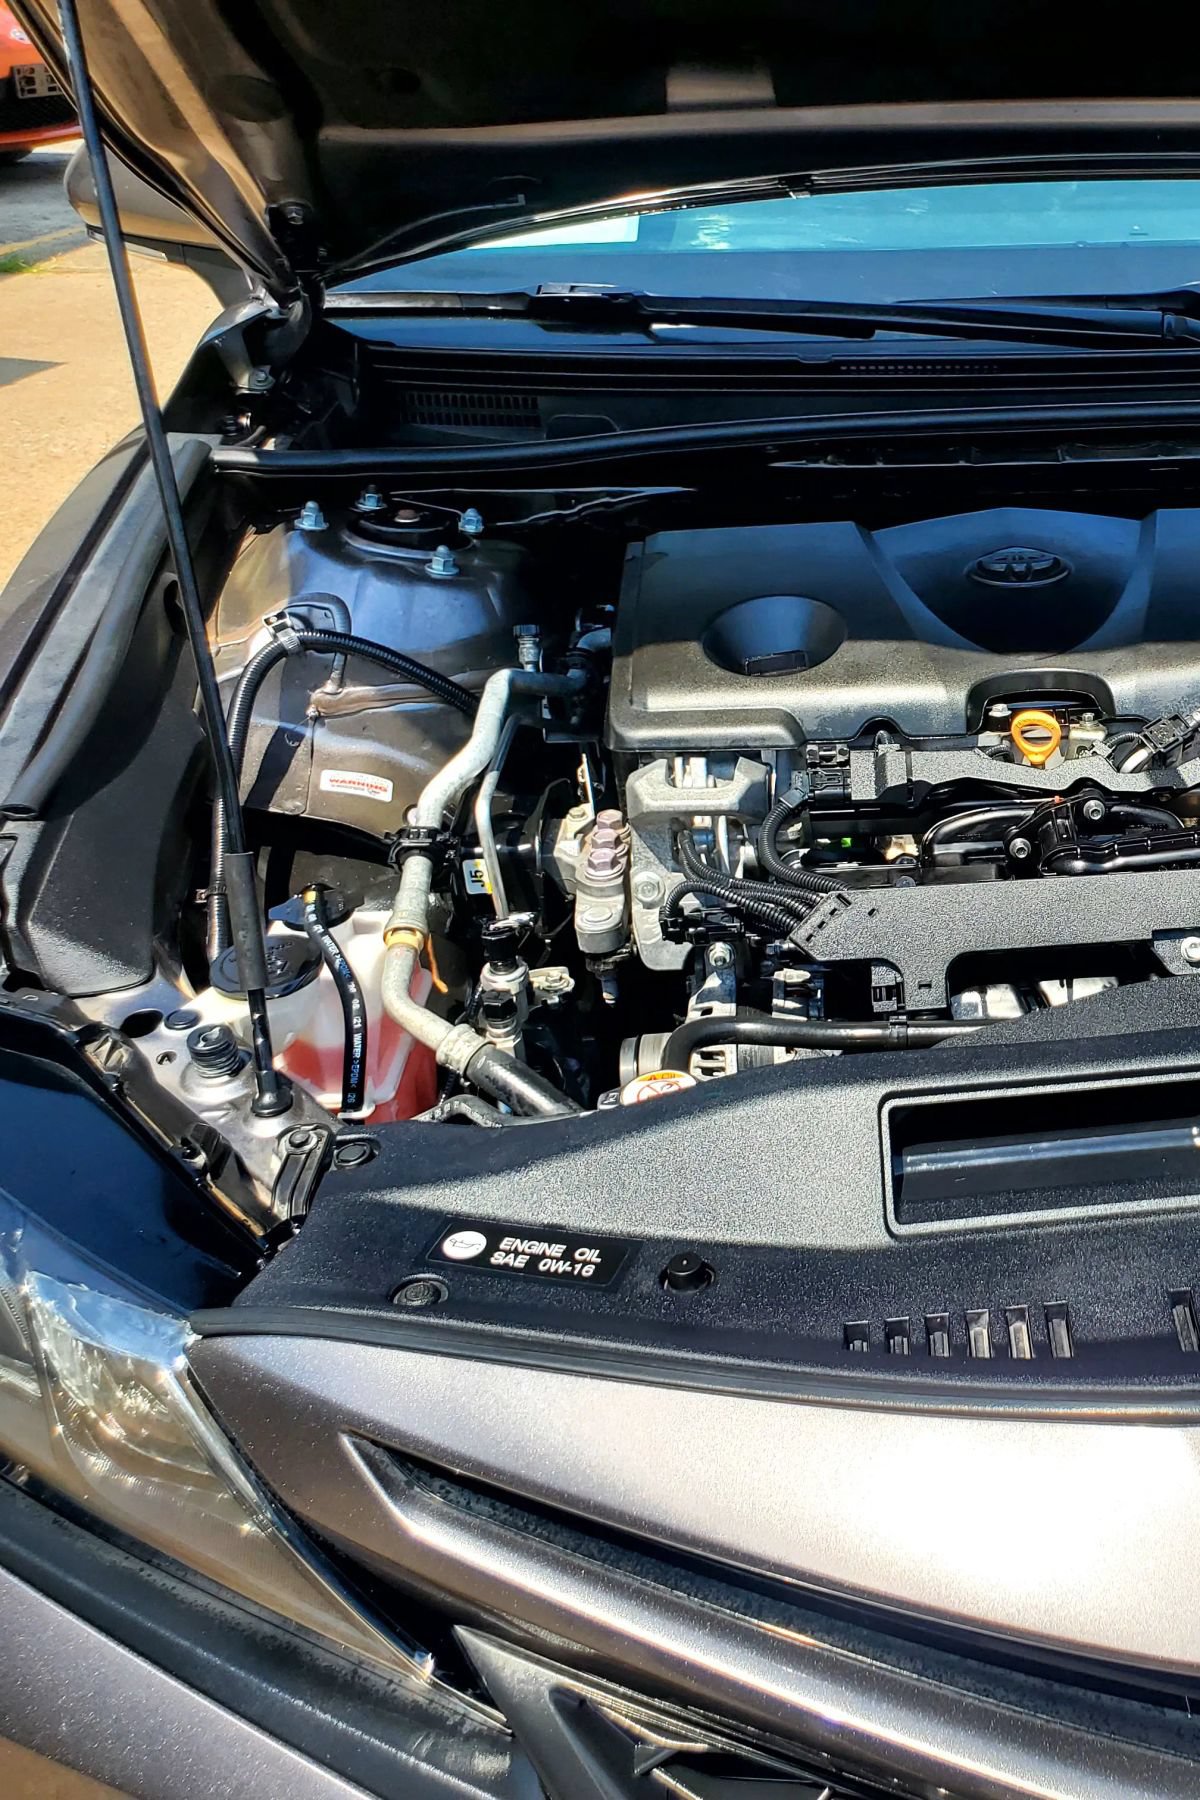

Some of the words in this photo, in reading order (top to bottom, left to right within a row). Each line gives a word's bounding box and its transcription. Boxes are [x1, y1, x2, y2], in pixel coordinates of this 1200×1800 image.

[329, 777, 388, 793] WARNING
[353, 1033, 362, 1058] WATER
[499, 1237, 566, 1257] ENGINE
[574, 1247, 602, 1262] OIL
[490, 1252, 529, 1268] SAE
[538, 1259, 595, 1277] 0W-16
